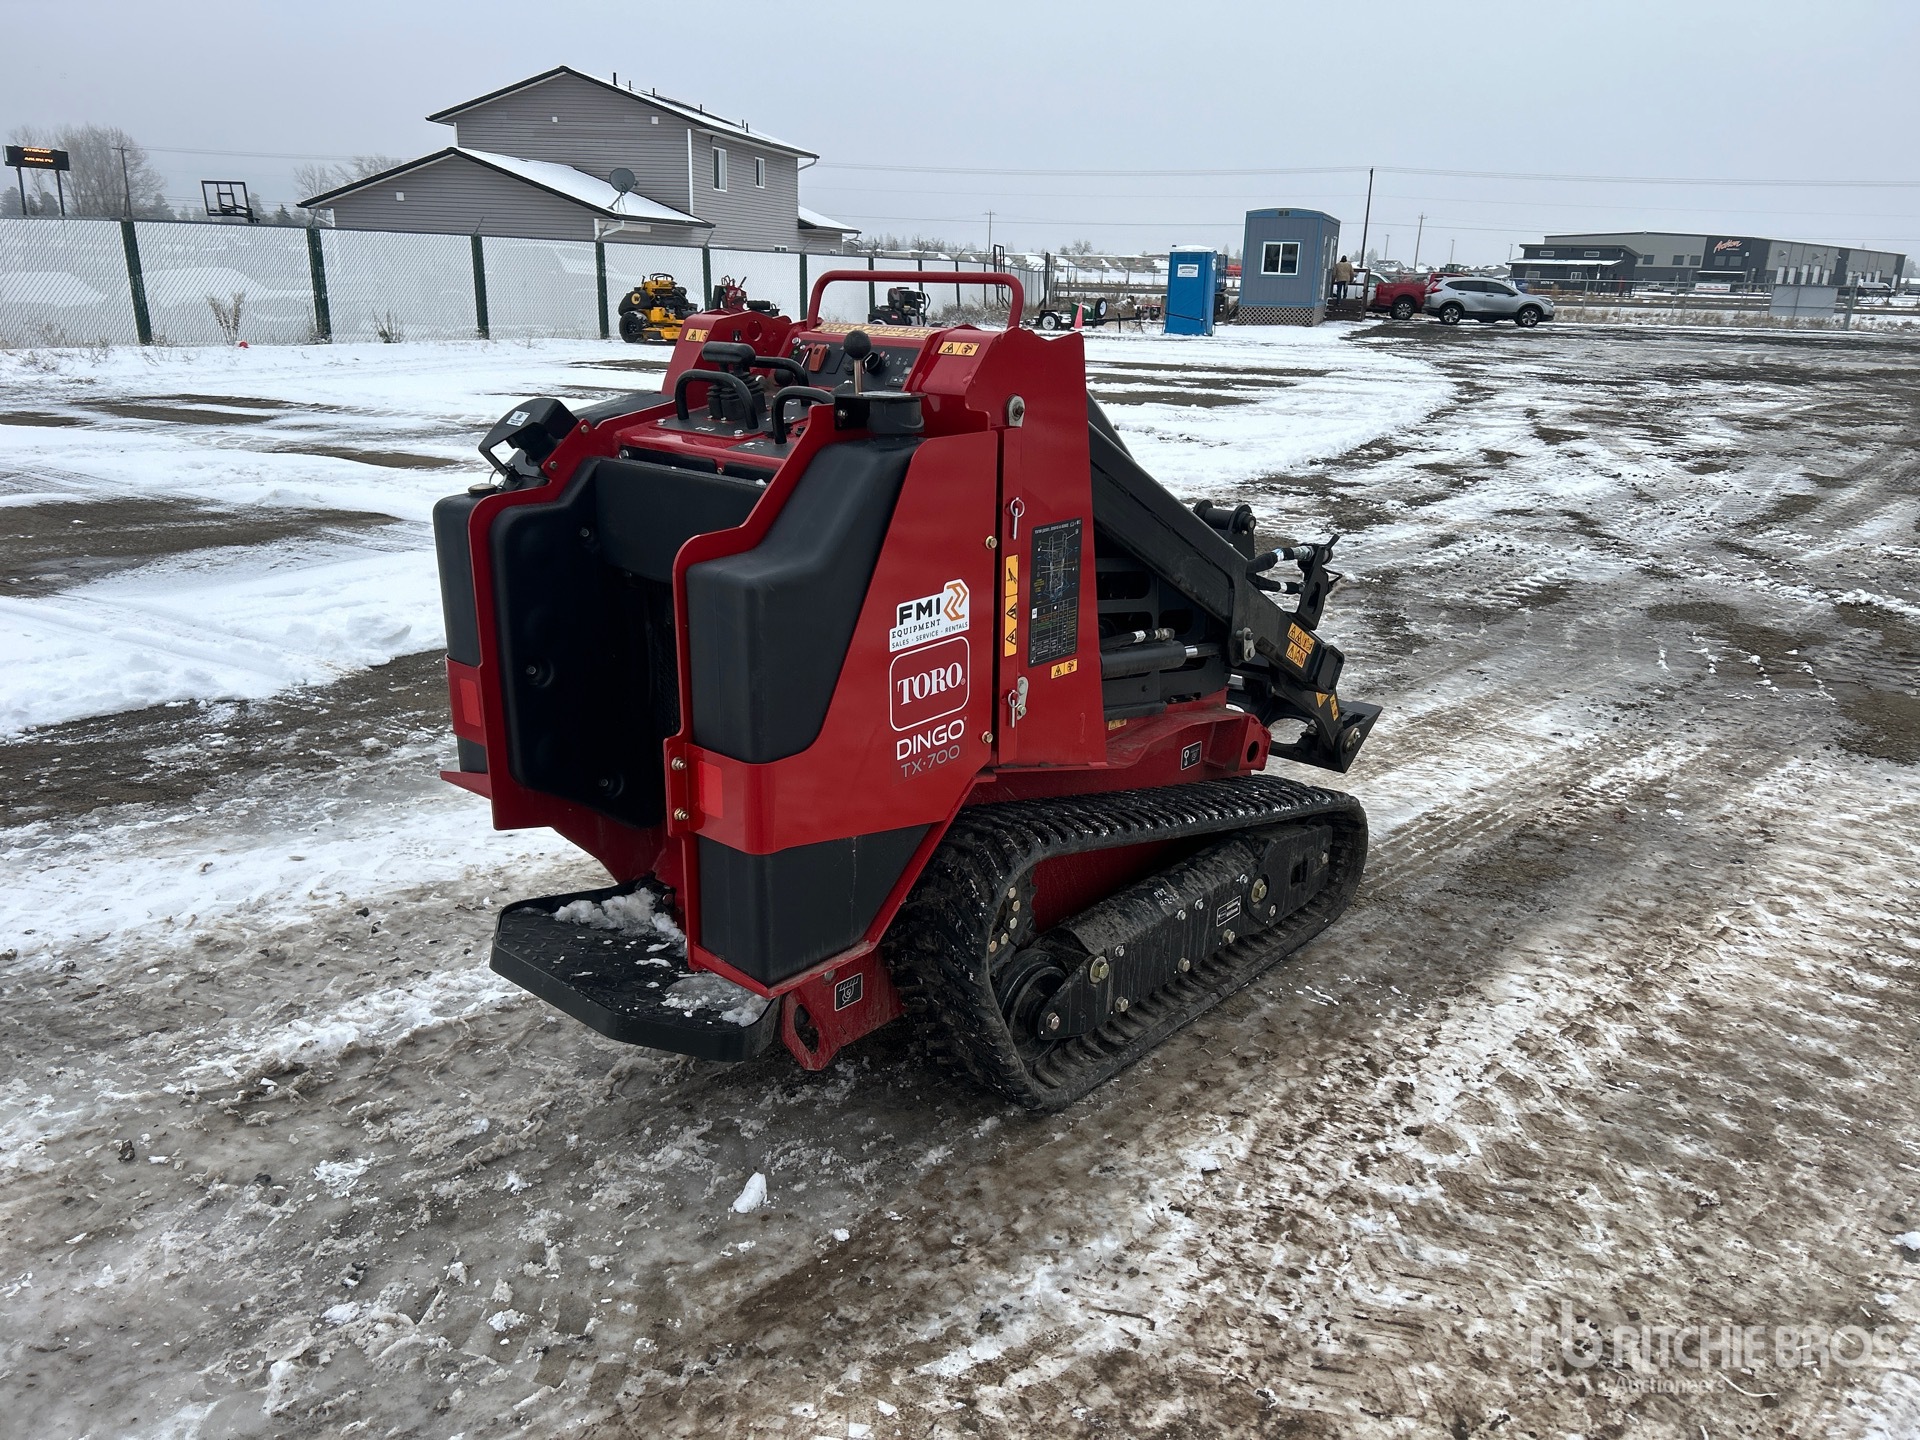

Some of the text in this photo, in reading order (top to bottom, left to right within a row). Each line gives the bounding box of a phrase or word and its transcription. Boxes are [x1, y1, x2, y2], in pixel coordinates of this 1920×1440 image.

[899, 597, 940, 626] FMI
[891, 618, 940, 639] EQUIPMENT
[891, 621, 969, 649] SALES SERVICE RENTALS
[897, 662, 963, 706] TORO
[896, 719, 965, 761] DINGO
